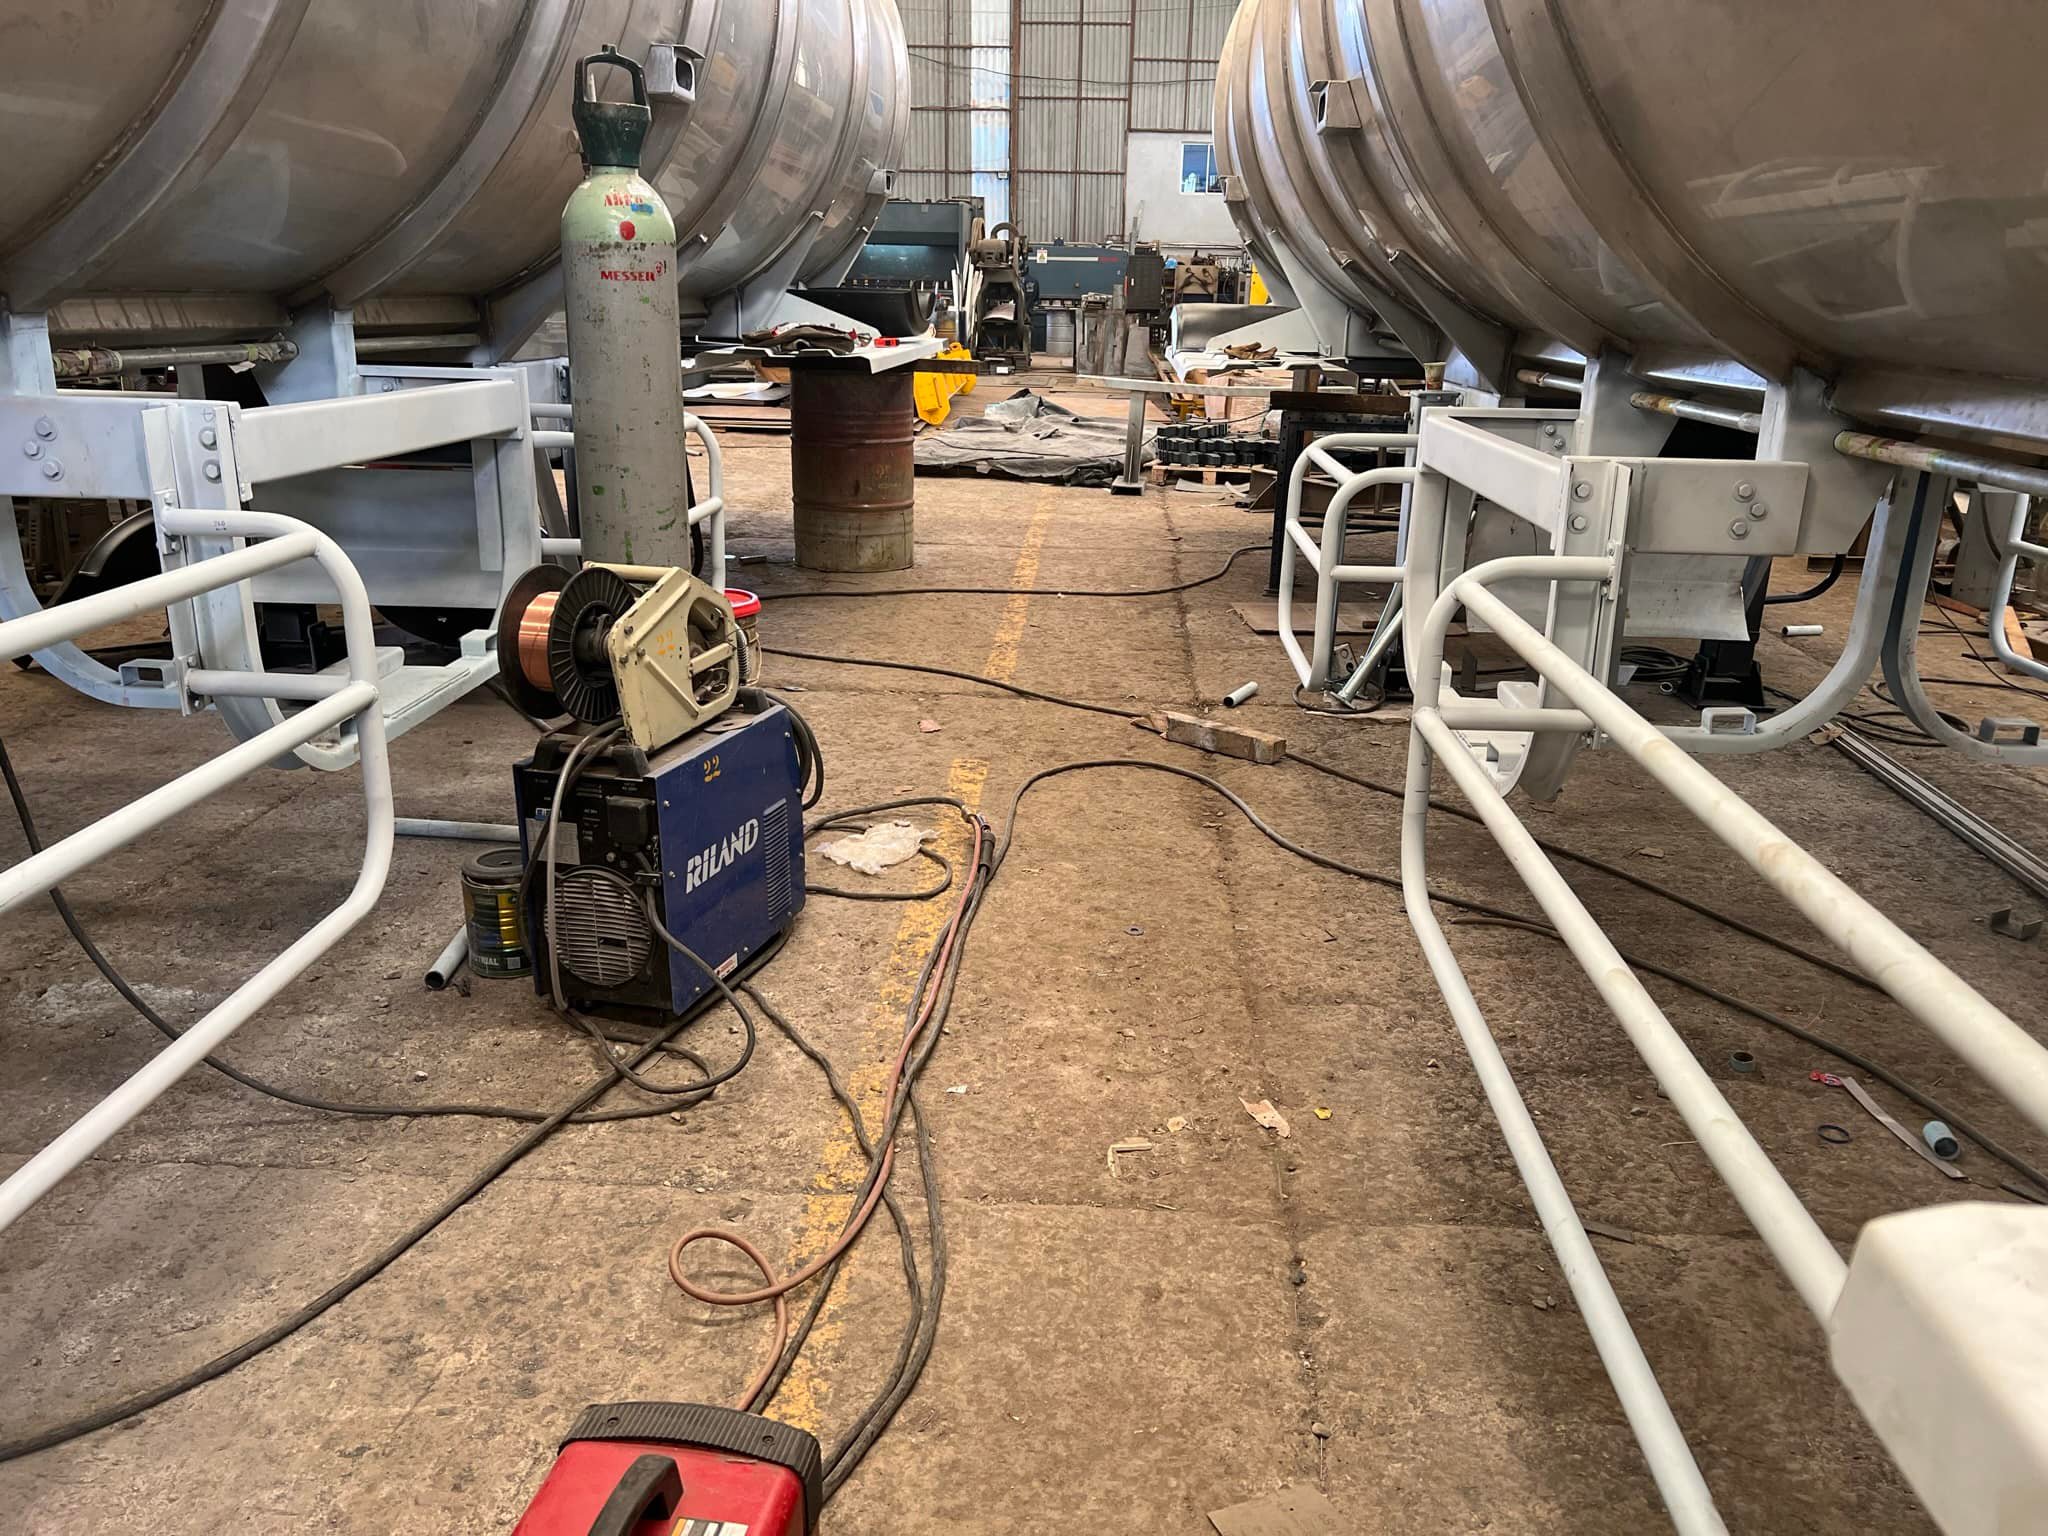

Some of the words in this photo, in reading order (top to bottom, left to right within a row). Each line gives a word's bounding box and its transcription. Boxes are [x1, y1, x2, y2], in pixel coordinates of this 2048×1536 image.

[601, 271, 656, 281] MESSER
[704, 755, 720, 782] 22
[686, 818, 759, 894] RILAND
